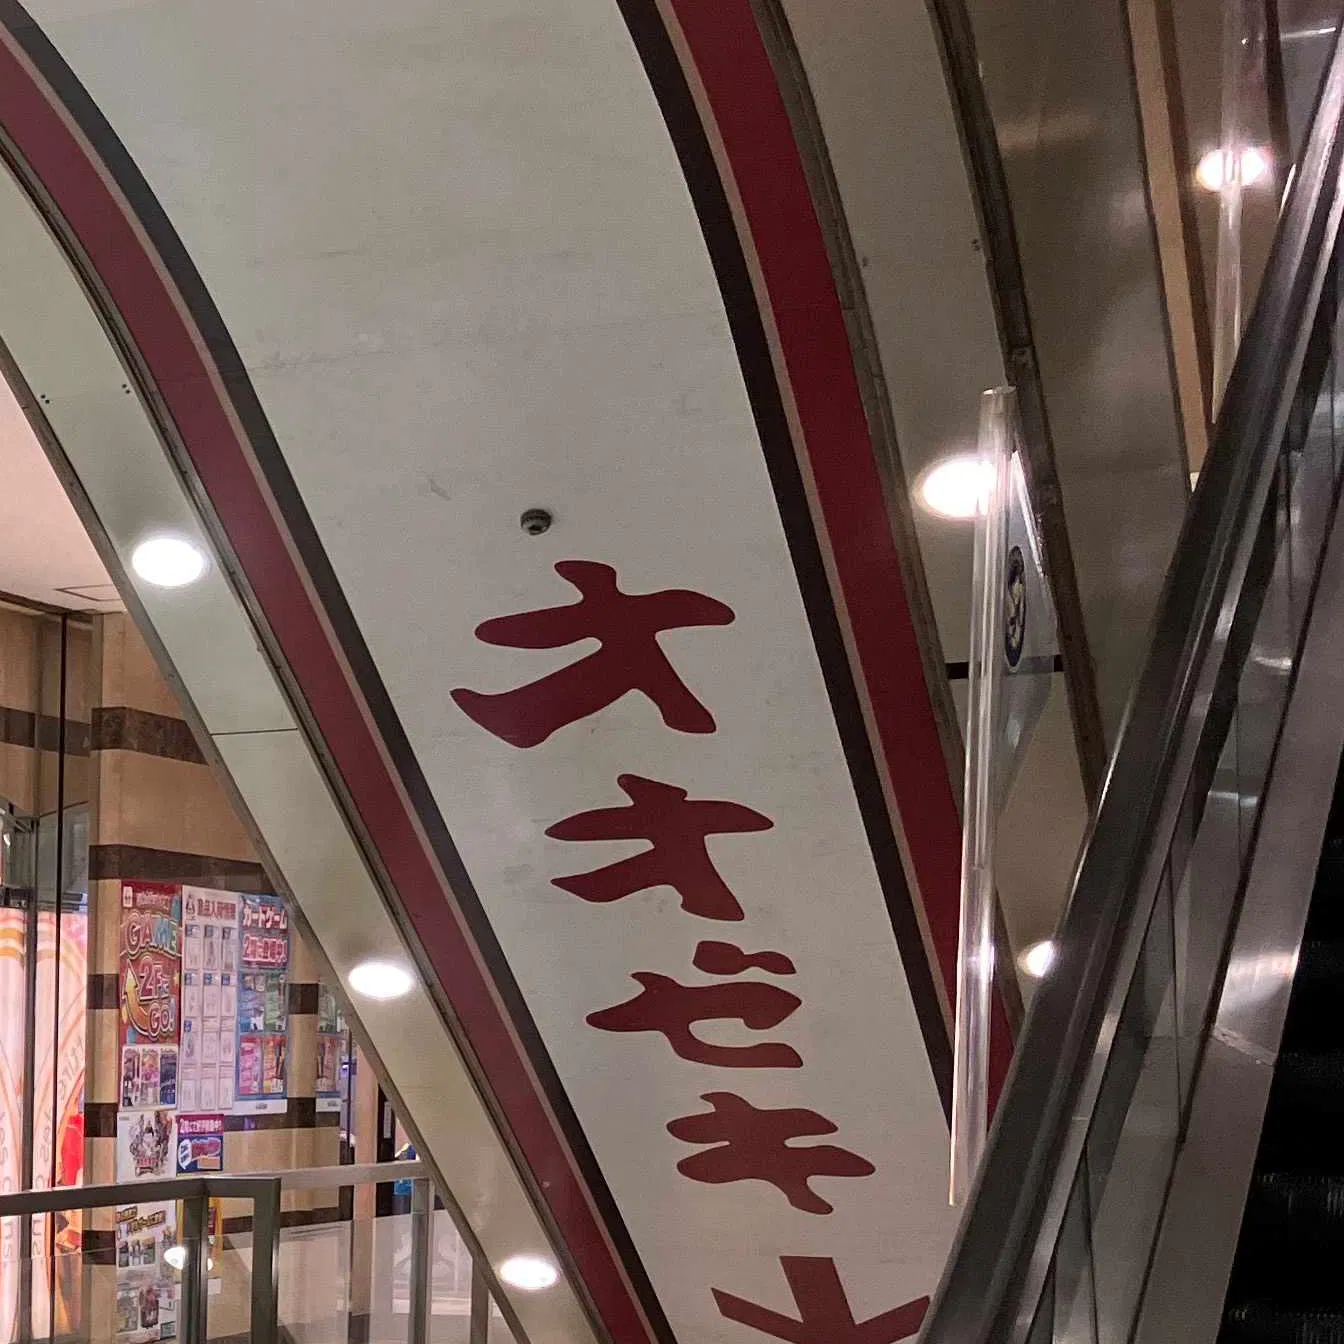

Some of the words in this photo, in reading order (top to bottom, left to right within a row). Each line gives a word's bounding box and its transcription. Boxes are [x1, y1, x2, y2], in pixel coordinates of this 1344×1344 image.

[451, 560, 876, 1215] オオゼキ
[126, 915, 179, 957] GAME
[243, 904, 289, 929] カードゲーム
